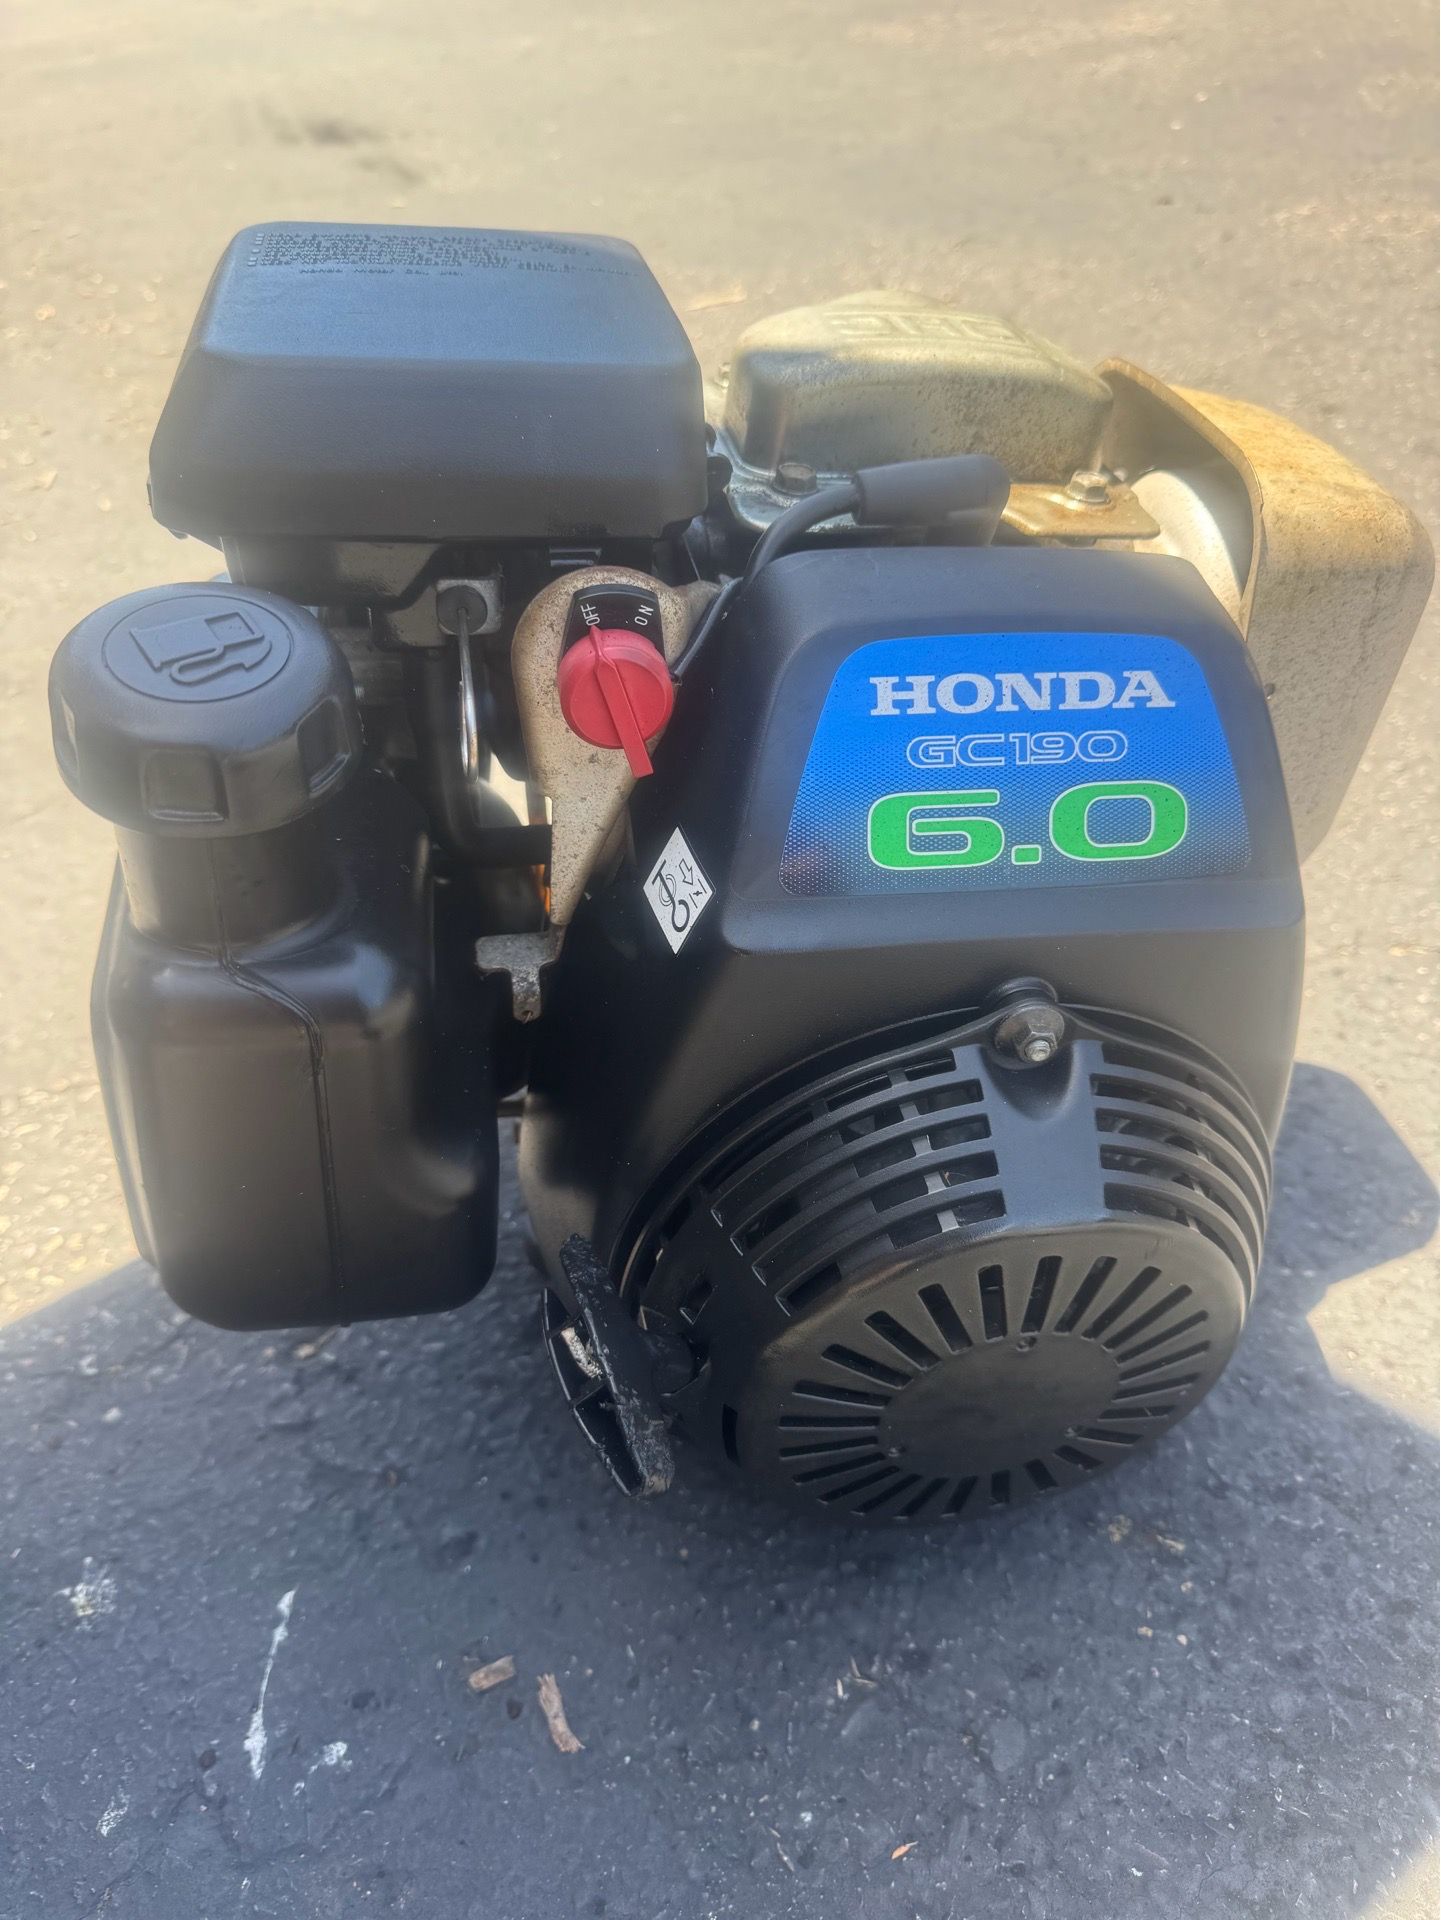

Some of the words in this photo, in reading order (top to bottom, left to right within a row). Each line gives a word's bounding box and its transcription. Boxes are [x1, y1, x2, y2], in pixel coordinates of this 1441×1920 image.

[581, 603, 600, 626] OFF
[634, 604, 655, 626] ON
[869, 670, 1176, 716] HONDA
[906, 730, 1129, 769] GC190
[867, 779, 1189, 870] 6.0
